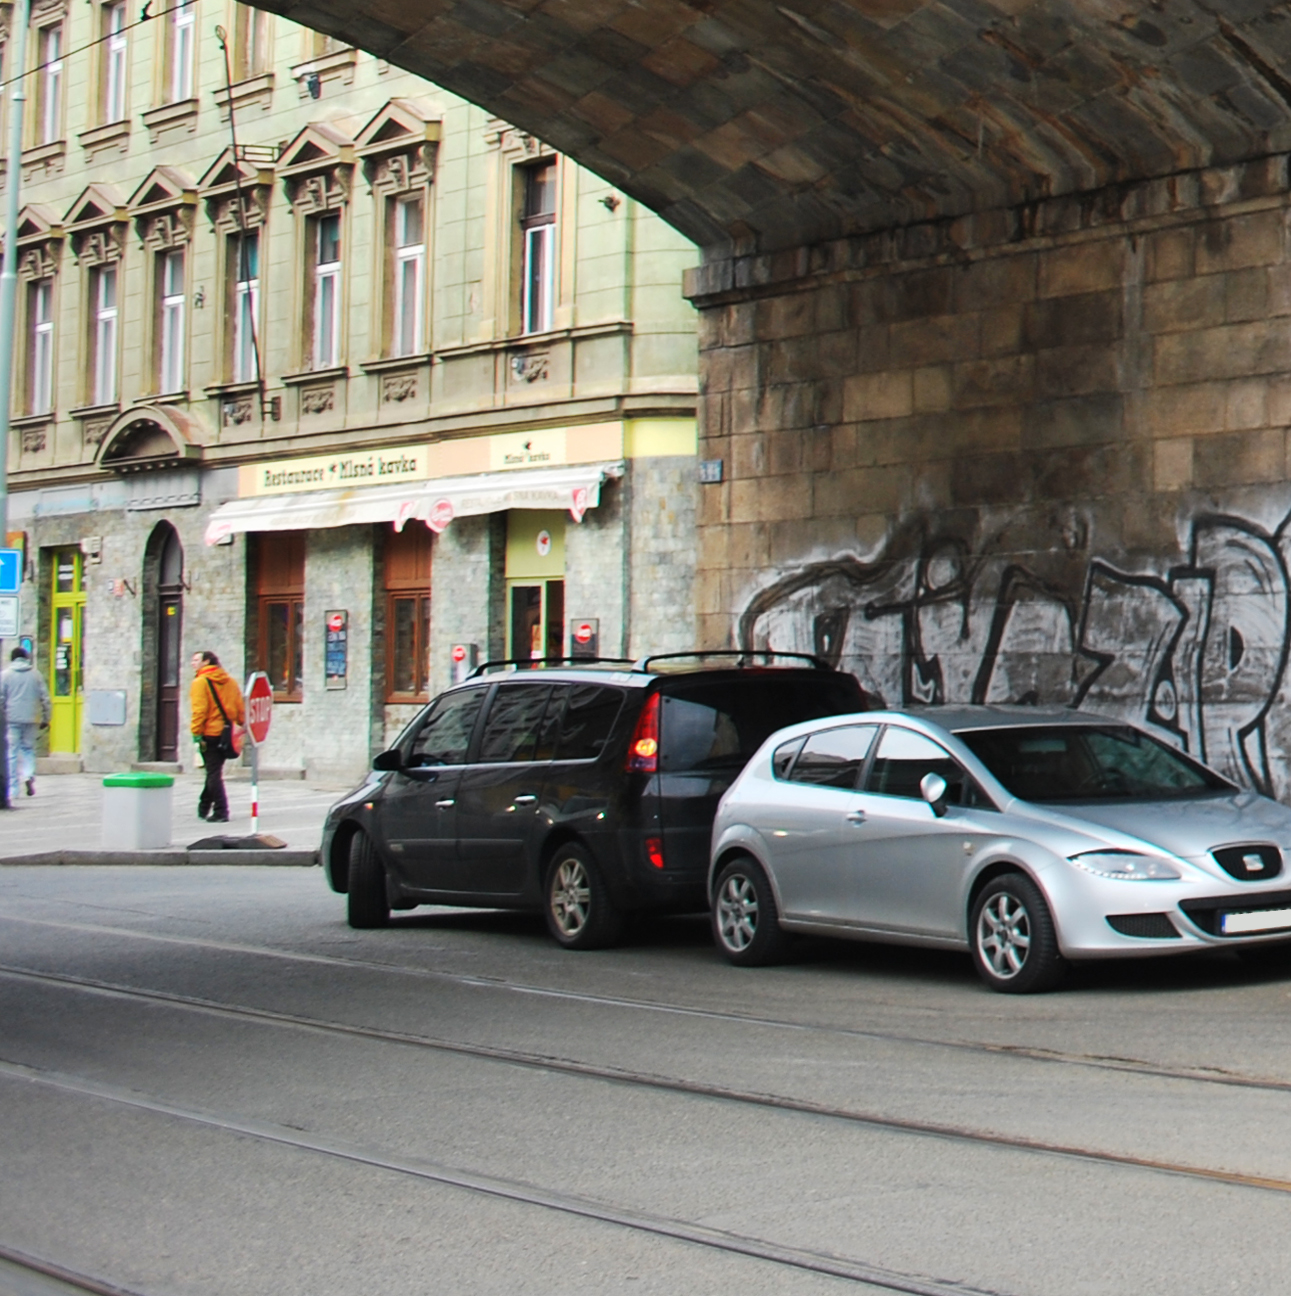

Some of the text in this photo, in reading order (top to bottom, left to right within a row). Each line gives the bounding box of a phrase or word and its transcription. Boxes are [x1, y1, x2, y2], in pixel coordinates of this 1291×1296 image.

[265, 455, 417, 486] Restaurace Mlsná kavka
[249, 696, 271, 724] STOP
